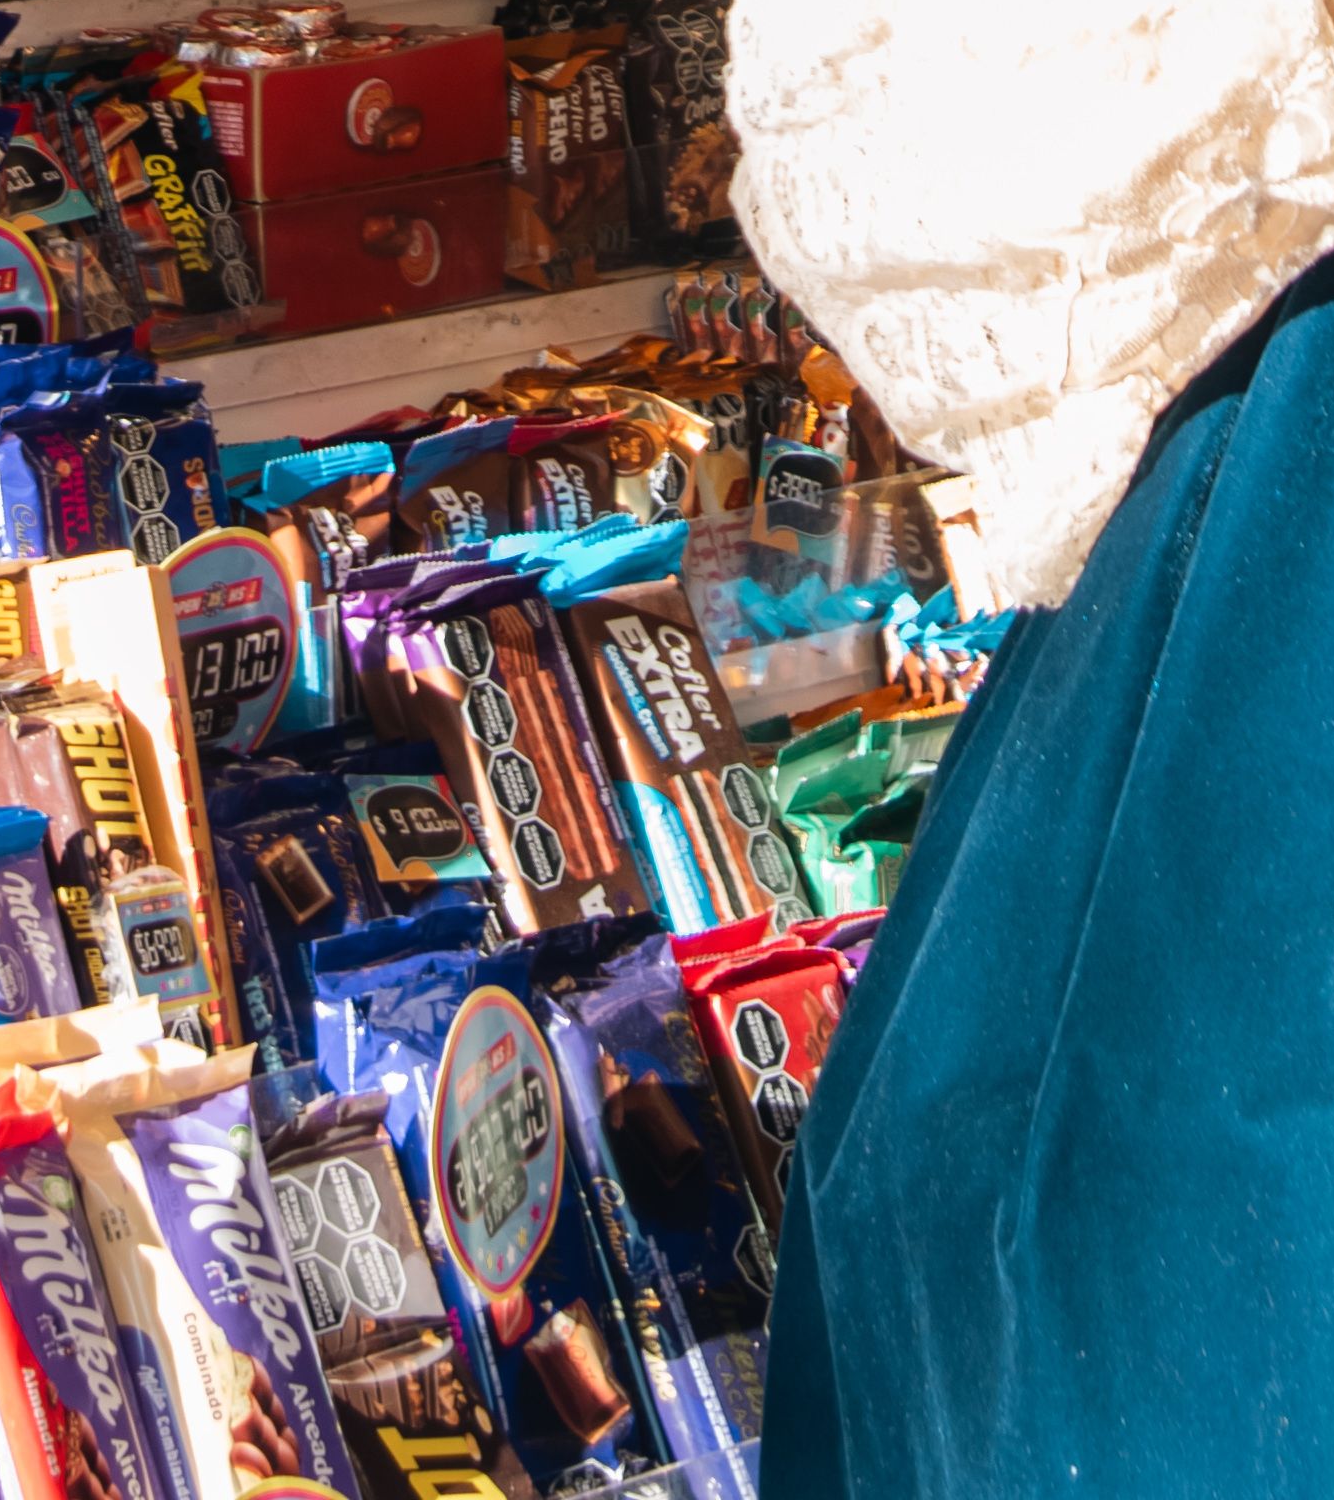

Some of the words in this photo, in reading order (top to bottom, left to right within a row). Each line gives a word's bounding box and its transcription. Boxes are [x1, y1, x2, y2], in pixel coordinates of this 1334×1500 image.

[604, 615, 707, 765] EXTRA
[657, 624, 722, 732] Cofler
[61, 711, 150, 854] SHOT
[167, 1140, 305, 1373] Milka
[21, 1367, 60, 1479] Almendras
[182, 1311, 223, 1423] Combinado
[285, 1381, 335, 1490] Aireado
